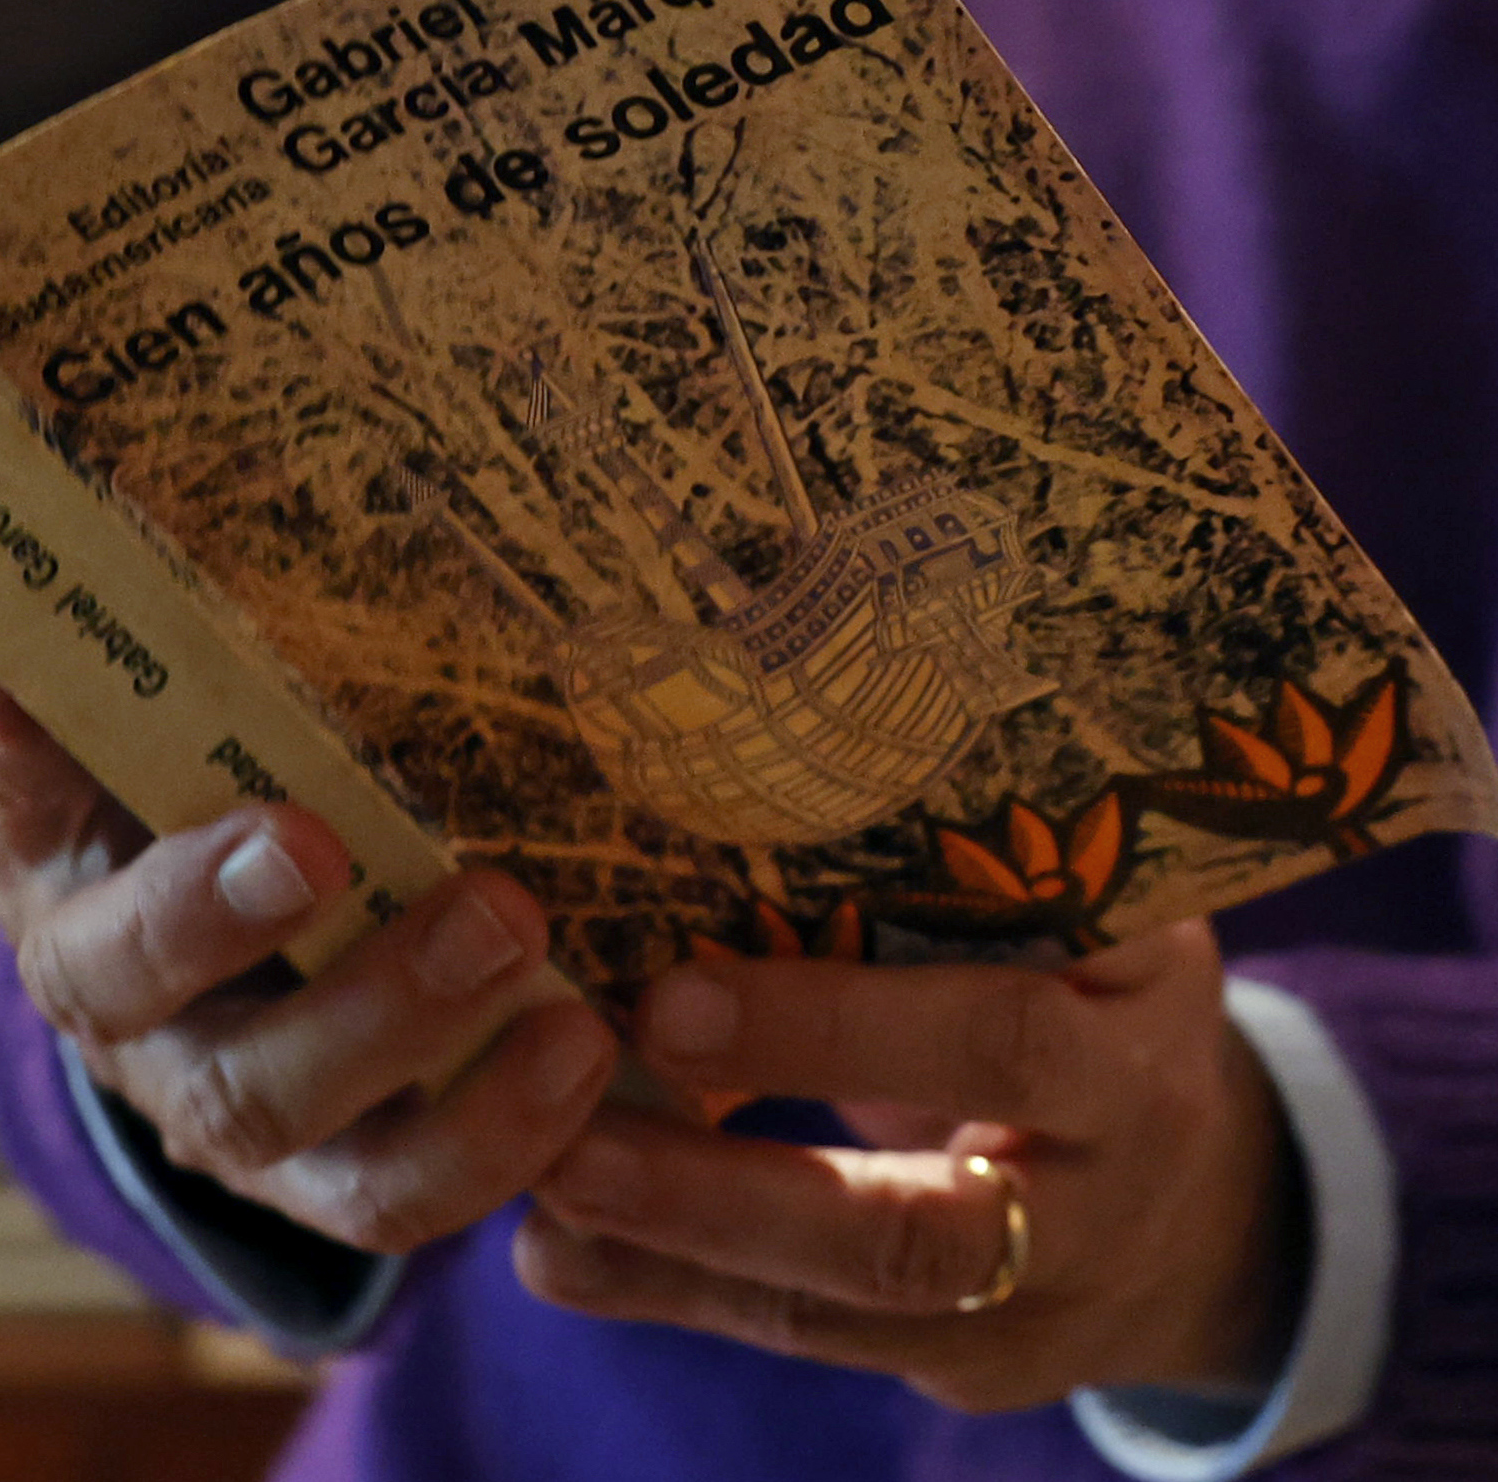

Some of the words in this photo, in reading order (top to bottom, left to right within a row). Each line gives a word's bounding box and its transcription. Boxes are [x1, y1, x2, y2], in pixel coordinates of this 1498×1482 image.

[283, 59, 511, 173] García
[41, 300, 229, 404] Cien
[238, 202, 431, 320] años
[444, 147, 550, 218] de
[55, 584, 170, 699] Gabriel
